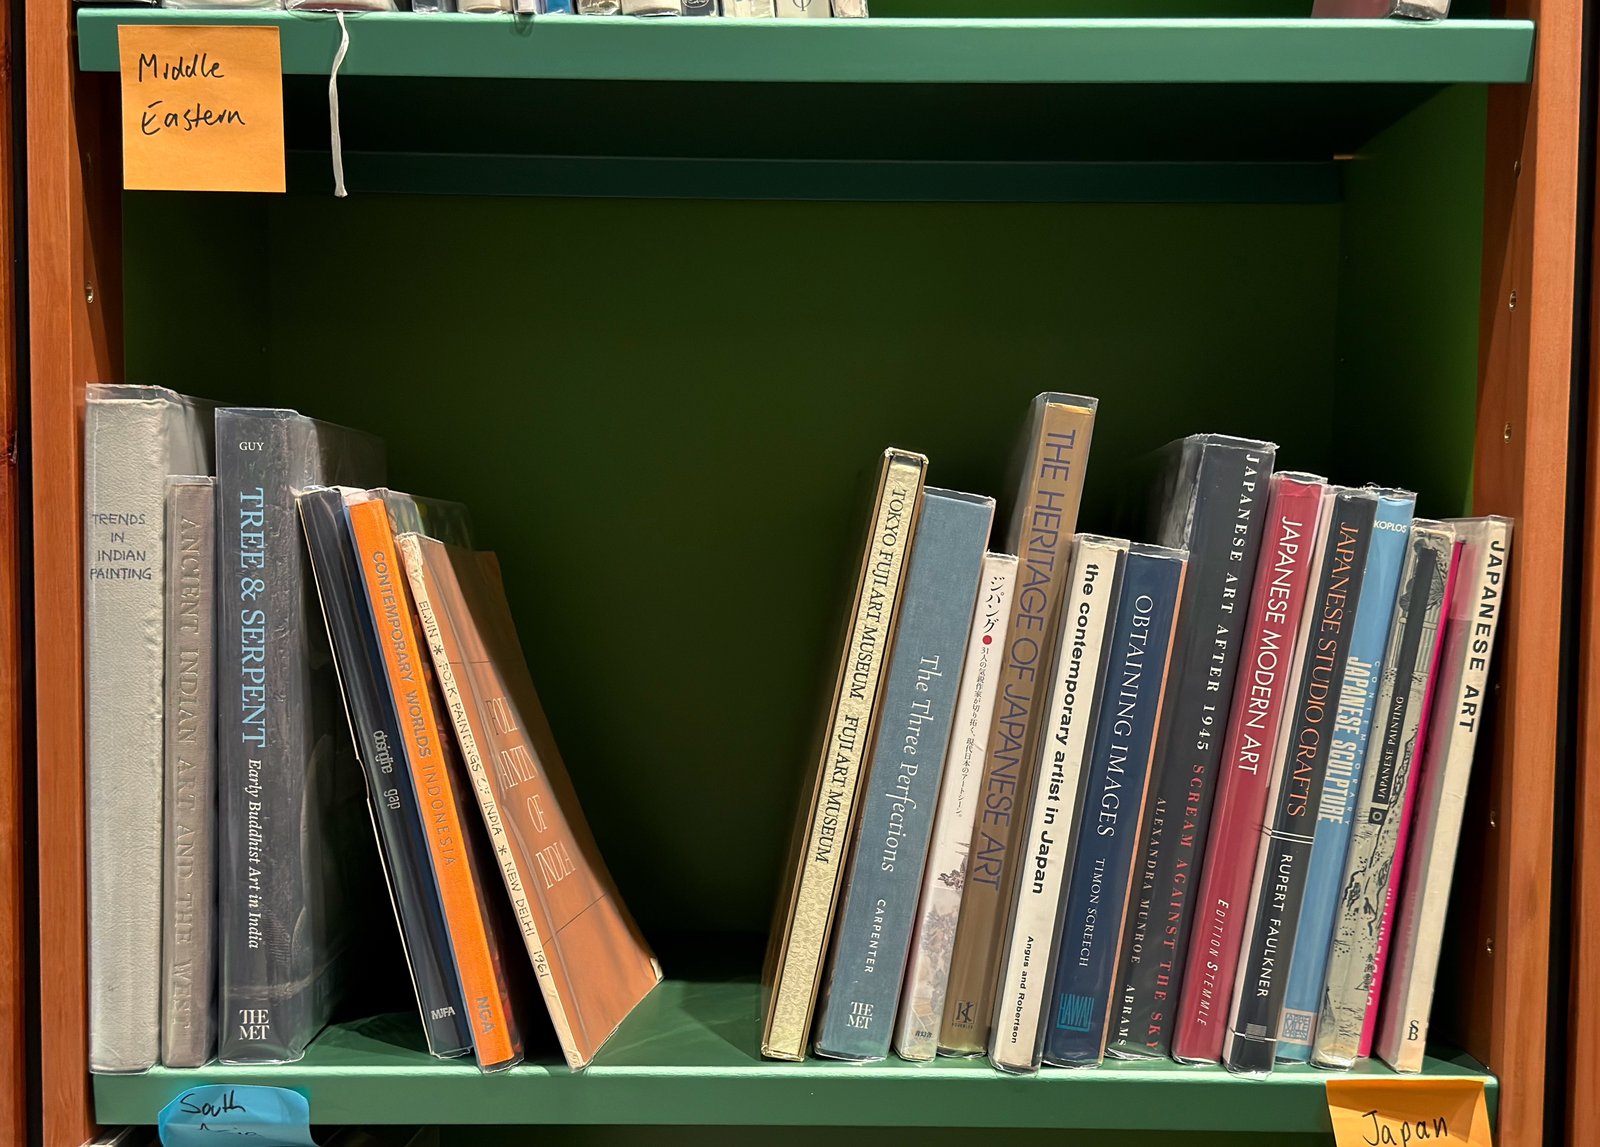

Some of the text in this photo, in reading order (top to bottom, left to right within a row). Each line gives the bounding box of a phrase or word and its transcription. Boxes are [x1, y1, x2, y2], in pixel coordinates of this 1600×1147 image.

[138, 53, 225, 82] Middle
[141, 100, 246, 136] Eastern
[239, 441, 265, 452] GUY
[92, 513, 147, 526] TRENDS
[97, 550, 147, 562] INDIAN
[110, 531, 125, 544] IN
[1373, 519, 1408, 534] KOPLOS
[89, 567, 152, 581] PAINTING
[239, 487, 267, 748] TREE & SERPENT
[983, 576, 1005, 634] ジパング
[1196, 453, 1260, 751] JAPANESE ART AFTER 1945
[815, 489, 907, 864] TOKYO FUJI ART MUSEUM FUJI ART MUSEUM
[972, 429, 1076, 890] THE HERITAGE OF JAPANESE ART
[1238, 515, 1303, 775] JAPANESE MODERN ART
[1286, 521, 1359, 818] JAPANESE STUDIO CRAFTS
[1457, 540, 1505, 733] JAPANESE ART
[372, 551, 457, 867] CONTEMPORARY WORLDS INDONESIA
[1032, 563, 1099, 895] the contemporary artist in Japan
[1097, 595, 1154, 838] OBTAINING IMAGES
[1317, 656, 1372, 825] JAPANESE SCULPTURE
[1377, 696, 1405, 799] JAPANESE PAINTING
[171, 517, 201, 1030] ANCIENT INDIAN ART AND THE WEST
[383, 787, 401, 810] gap
[418, 600, 439, 639] ELWIN
[450, 702, 482, 773] PAINTINGS
[482, 800, 503, 837] INDIA
[504, 862, 522, 893] NEW
[515, 899, 535, 937] DELHI
[533, 950, 550, 979] 1961
[527, 794, 548, 834] OF
[881, 654, 943, 872] The Three Perfections
[243, 758, 263, 949] Early Buddhist Art in India
[535, 840, 577, 890] INDIA
[1130, 796, 1167, 965] ALEXANDRA MUNROE
[864, 898, 887, 974] CARPENTER
[1078, 858, 1106, 967] TIMON SCREECH
[1146, 764, 1206, 1050] SCREAM AGAINST THE SKY
[1256, 853, 1293, 998] RUPERT FAULKNER
[851, 1001, 874, 1017] THE
[1010, 935, 1035, 1044] Angus and Robertson
[1197, 898, 1230, 1026] EDITION STEMMLE
[239, 1008, 269, 1024] THE
[239, 1024, 270, 1040] MET
[475, 996, 496, 1035] NGA
[847, 1016, 873, 1030] MET
[1117, 983, 1136, 1046] ABRAMS
[180, 1089, 247, 1118] South
[1361, 1109, 1449, 1147] Japan
